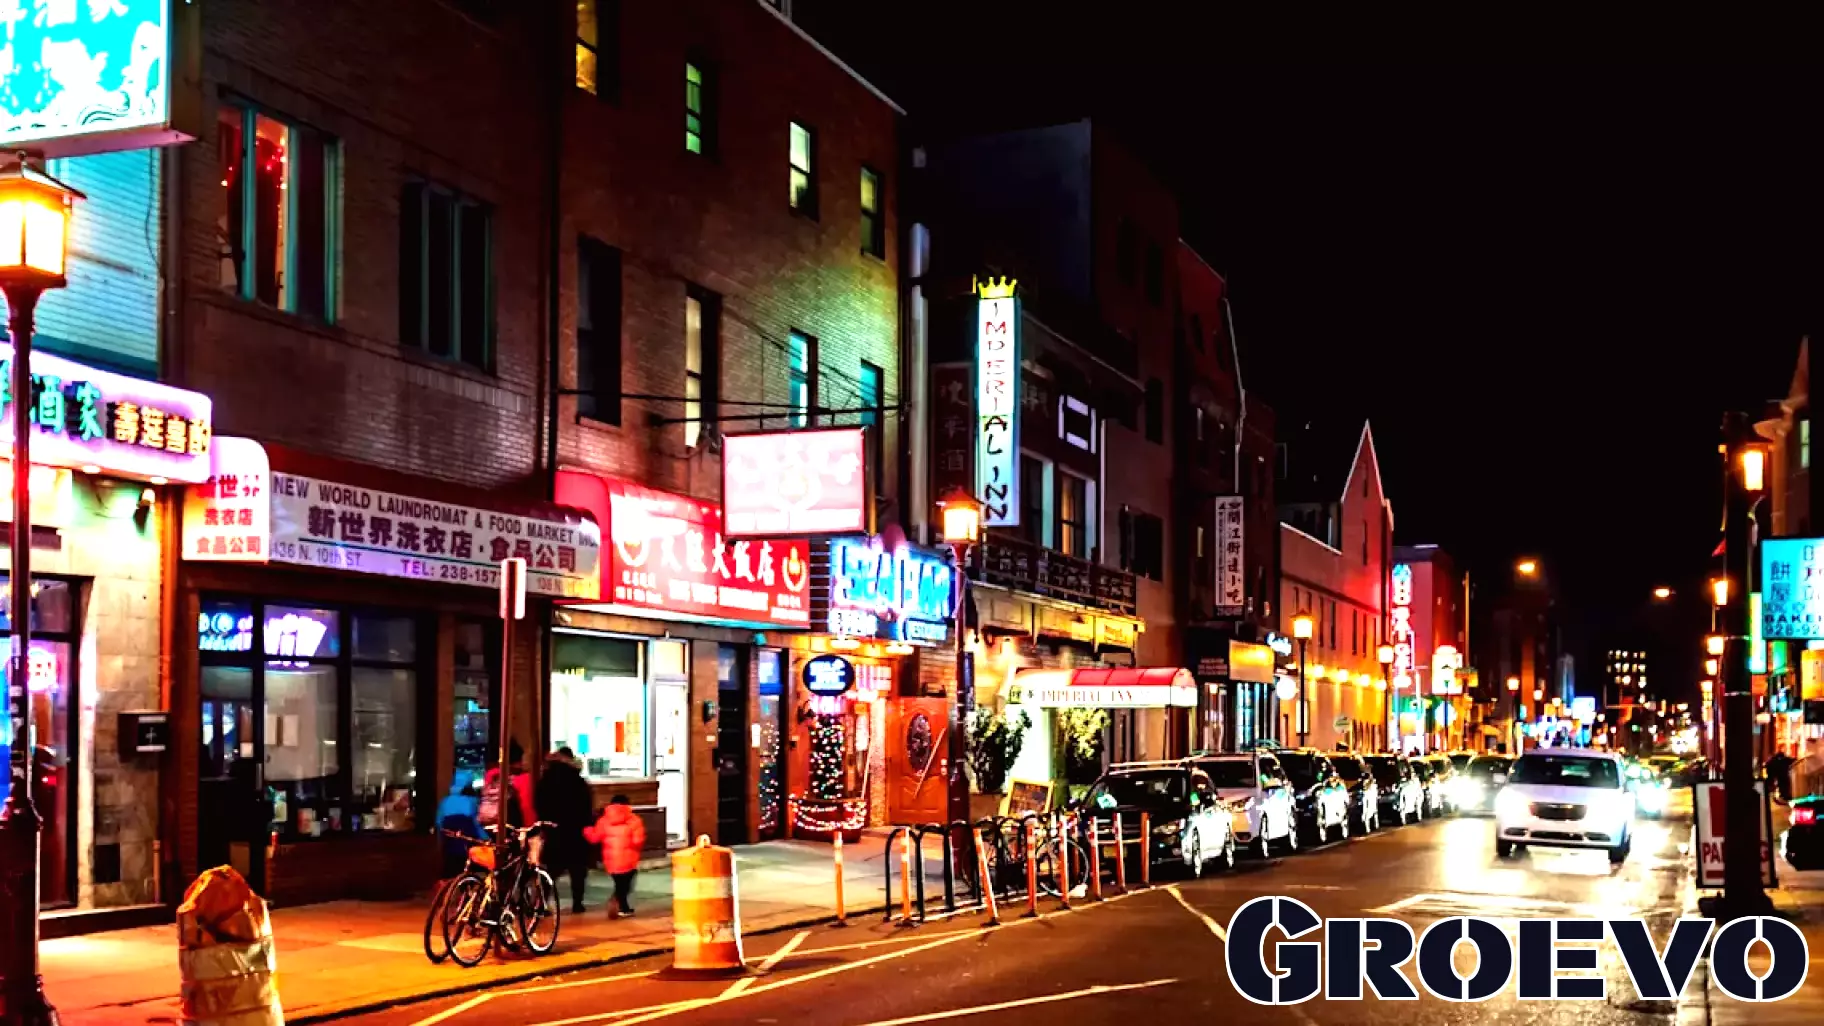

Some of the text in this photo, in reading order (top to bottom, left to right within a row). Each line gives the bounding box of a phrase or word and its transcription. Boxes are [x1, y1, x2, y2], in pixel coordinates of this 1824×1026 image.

[983, 301, 1008, 521] IMPERIAL INN
[204, 507, 254, 526] 洗衣店
[272, 476, 310, 499] NEW
[318, 483, 371, 509] WORLD
[377, 493, 468, 526] LAUNDROMAT
[474, 514, 483, 530] &
[489, 515, 522, 535] FOOD
[527, 520, 574, 546] MARKET
[196, 535, 262, 555] 食品公司
[401, 557, 501, 585] TEL: 238-157
